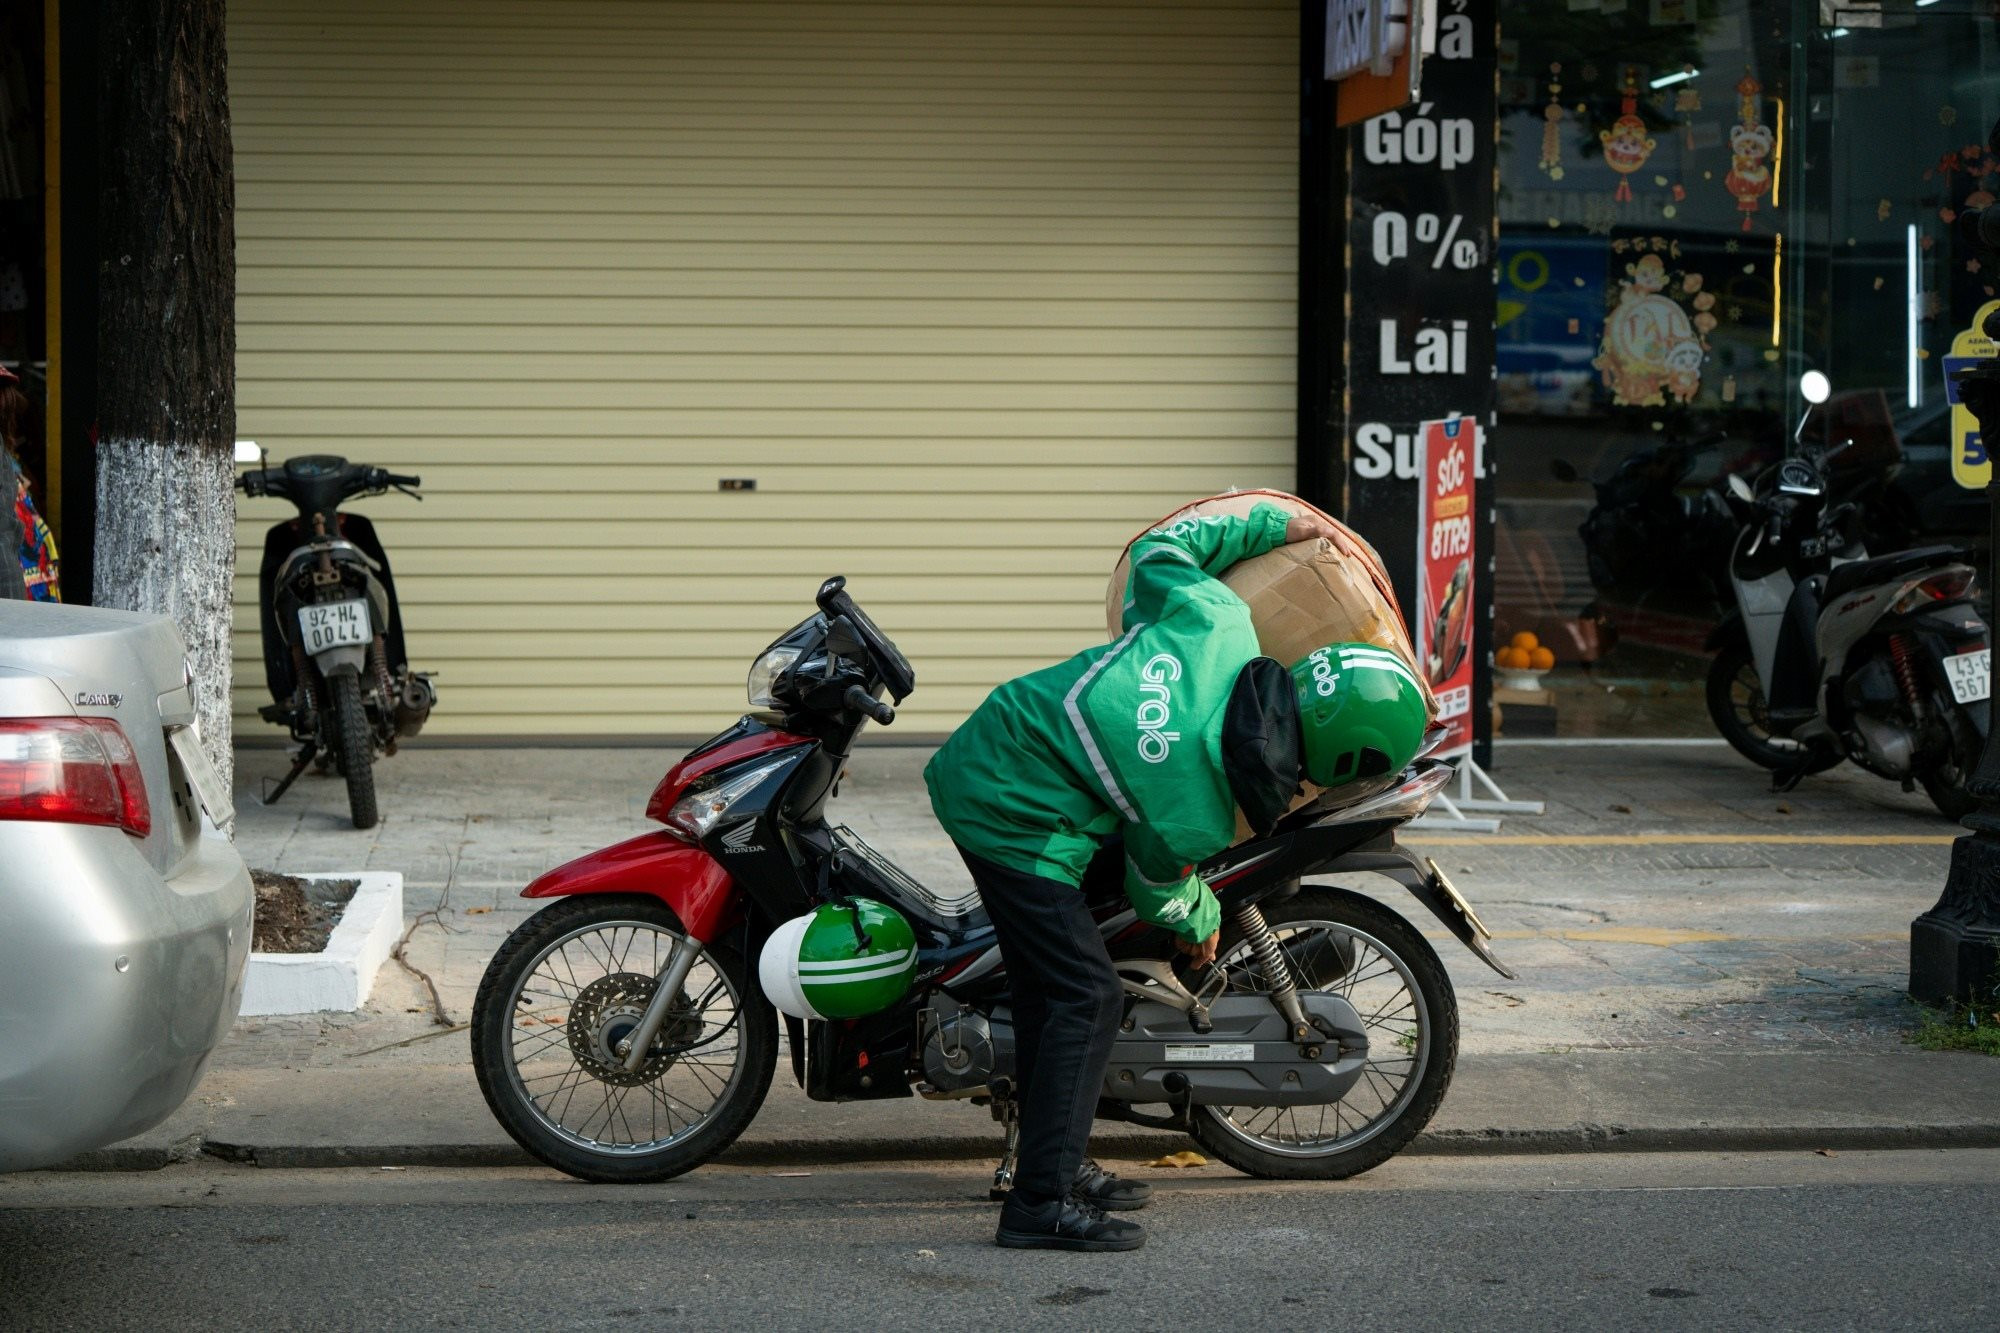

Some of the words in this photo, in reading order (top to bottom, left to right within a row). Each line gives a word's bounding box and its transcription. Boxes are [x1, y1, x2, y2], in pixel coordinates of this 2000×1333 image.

[1363, 102, 1475, 170] Góp
[1354, 411, 1487, 480] Sut
[1431, 514, 1471, 561] 8TR9
[309, 605, 358, 627] 92-H4
[312, 623, 361, 648] 0044
[1308, 646, 1341, 697] Grab
[1955, 654, 1991, 677] 43-G
[1954, 675, 1986, 698] 567
[1136, 653, 1182, 764] Grab
[724, 845, 767, 854] HONDA
